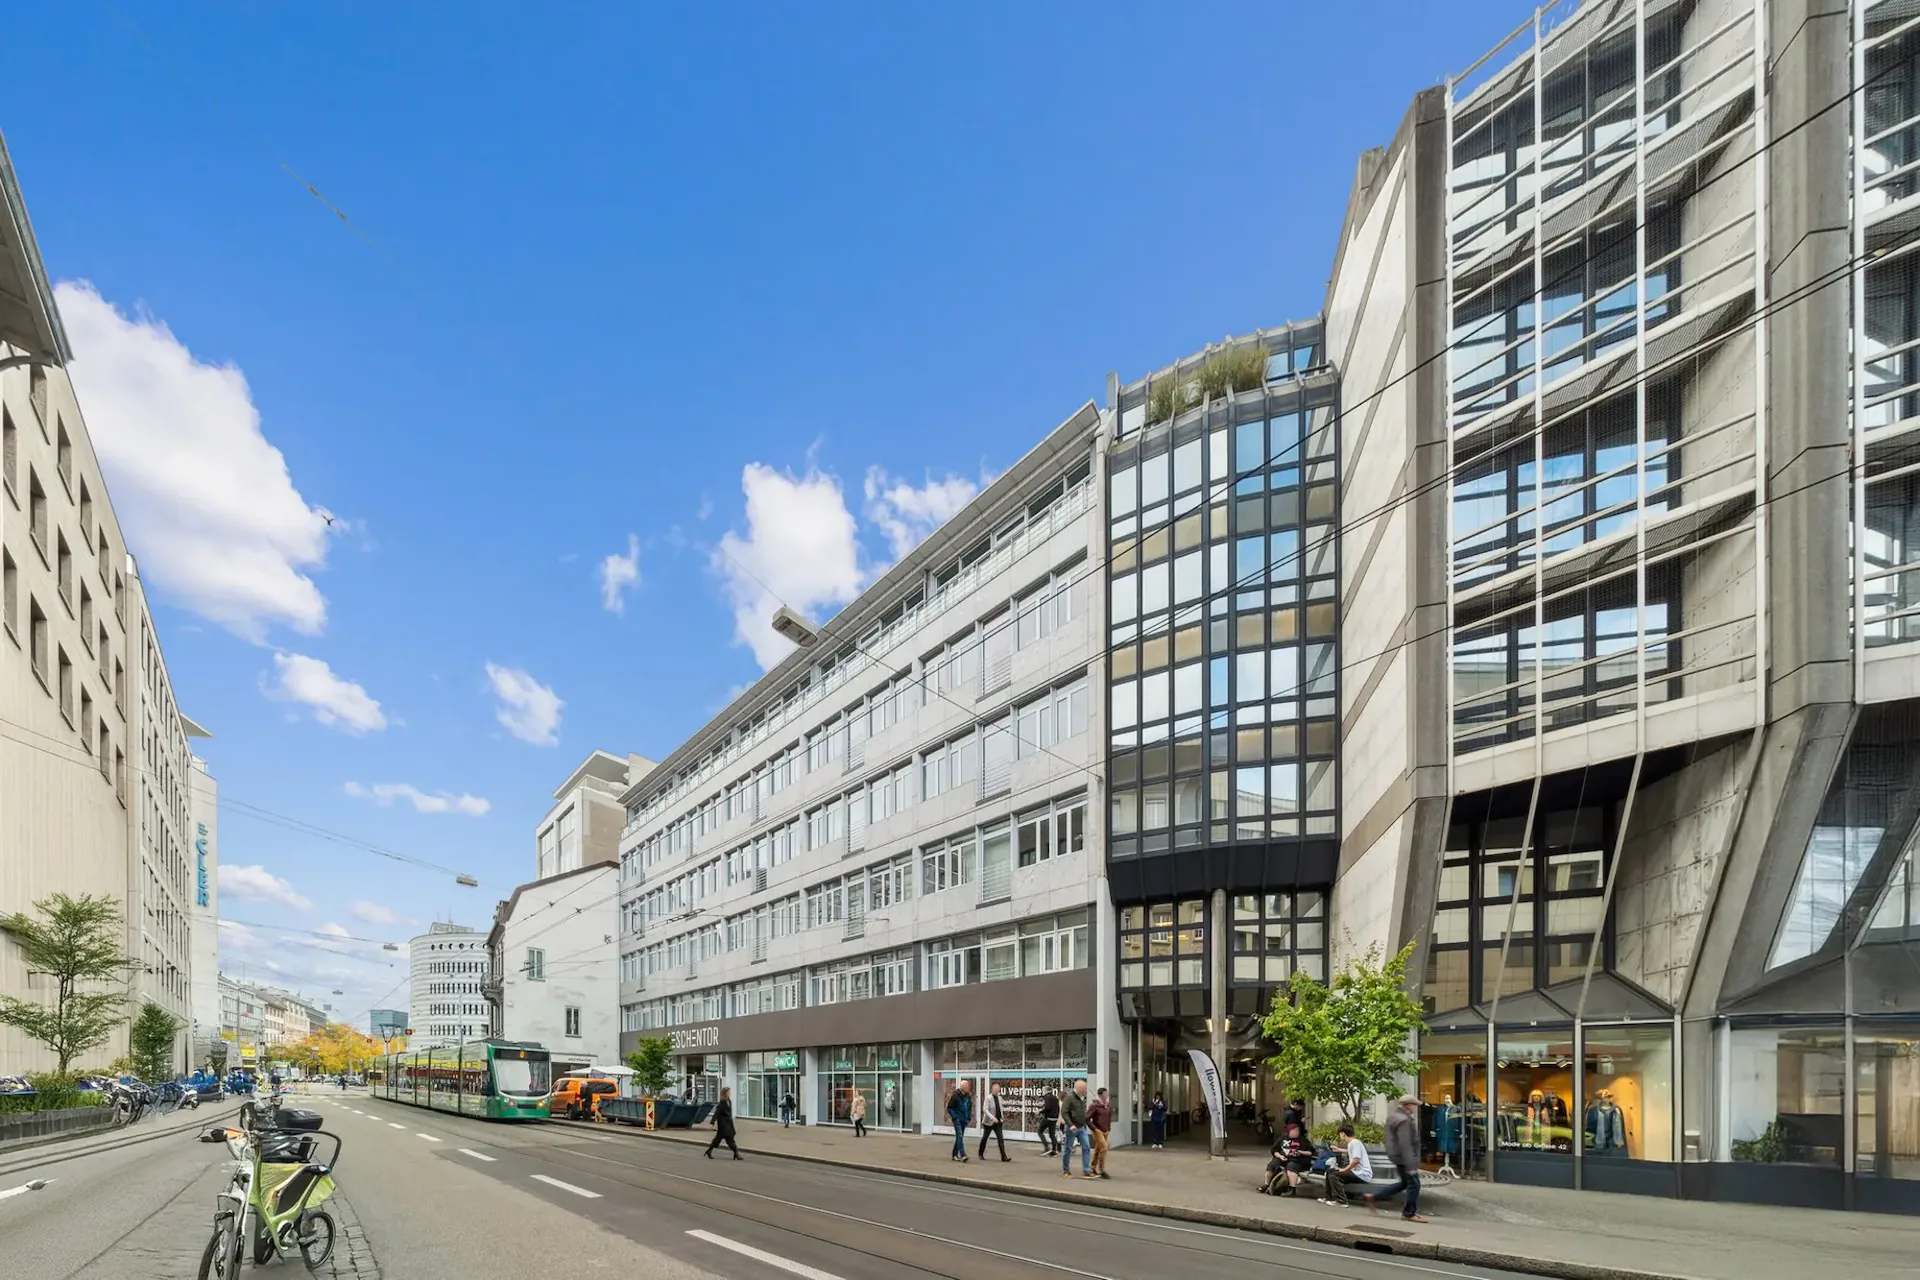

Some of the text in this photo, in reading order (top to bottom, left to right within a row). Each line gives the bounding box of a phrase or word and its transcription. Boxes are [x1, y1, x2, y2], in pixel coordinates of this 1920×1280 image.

[668, 1027, 719, 1048] ESCHENTOR
[774, 1057, 796, 1067] SWICA
[1008, 1085, 1058, 1097] vermien
